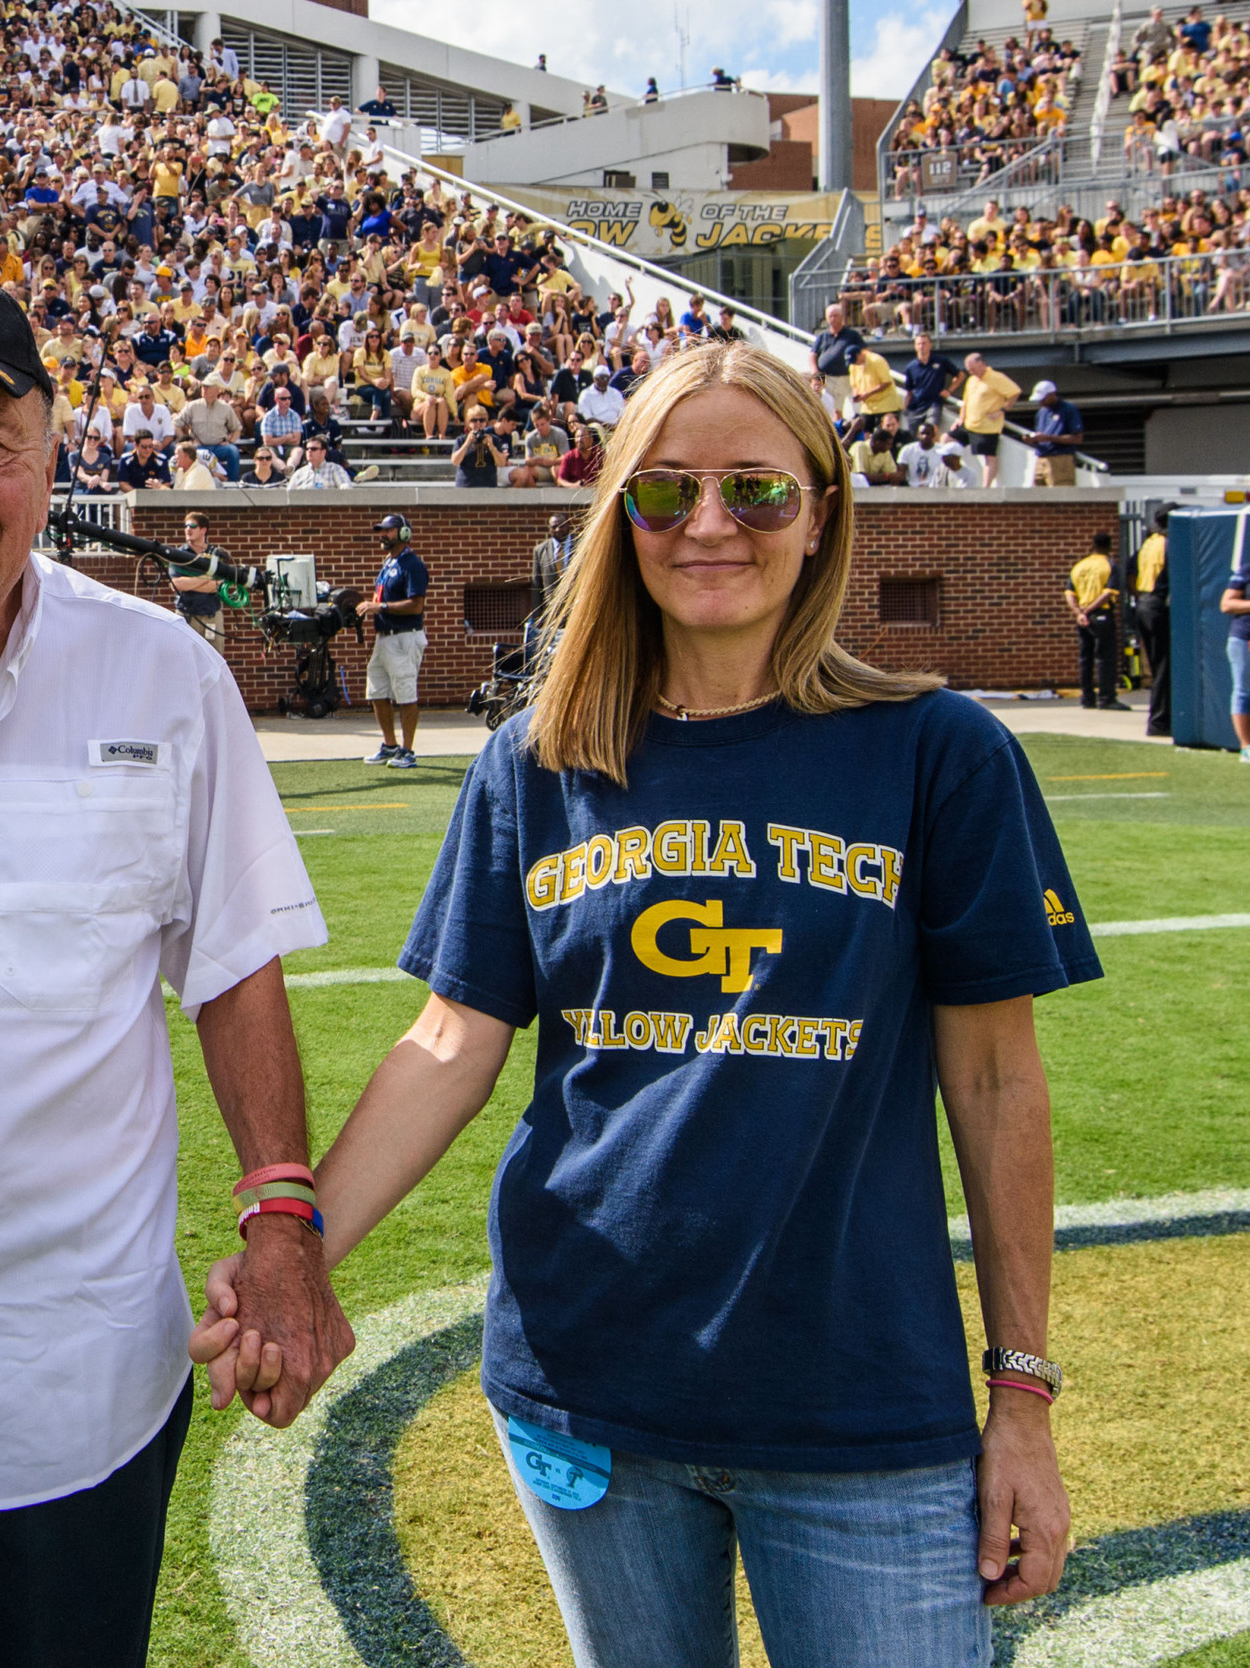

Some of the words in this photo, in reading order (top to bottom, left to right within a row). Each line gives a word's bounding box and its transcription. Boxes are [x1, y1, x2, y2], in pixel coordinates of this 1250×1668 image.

[929, 160, 951, 175] 112
[566, 201, 642, 218] HOME
[700, 204, 728, 220] OF
[740, 204, 788, 221] THE
[117, 744, 153, 756] Columbia
[525, 819, 757, 911] GEORGIA
[767, 823, 904, 910] TECH
[630, 899, 782, 993] GT
[695, 1013, 864, 1060] JACKETS
[526, 1451, 552, 1476] GT
